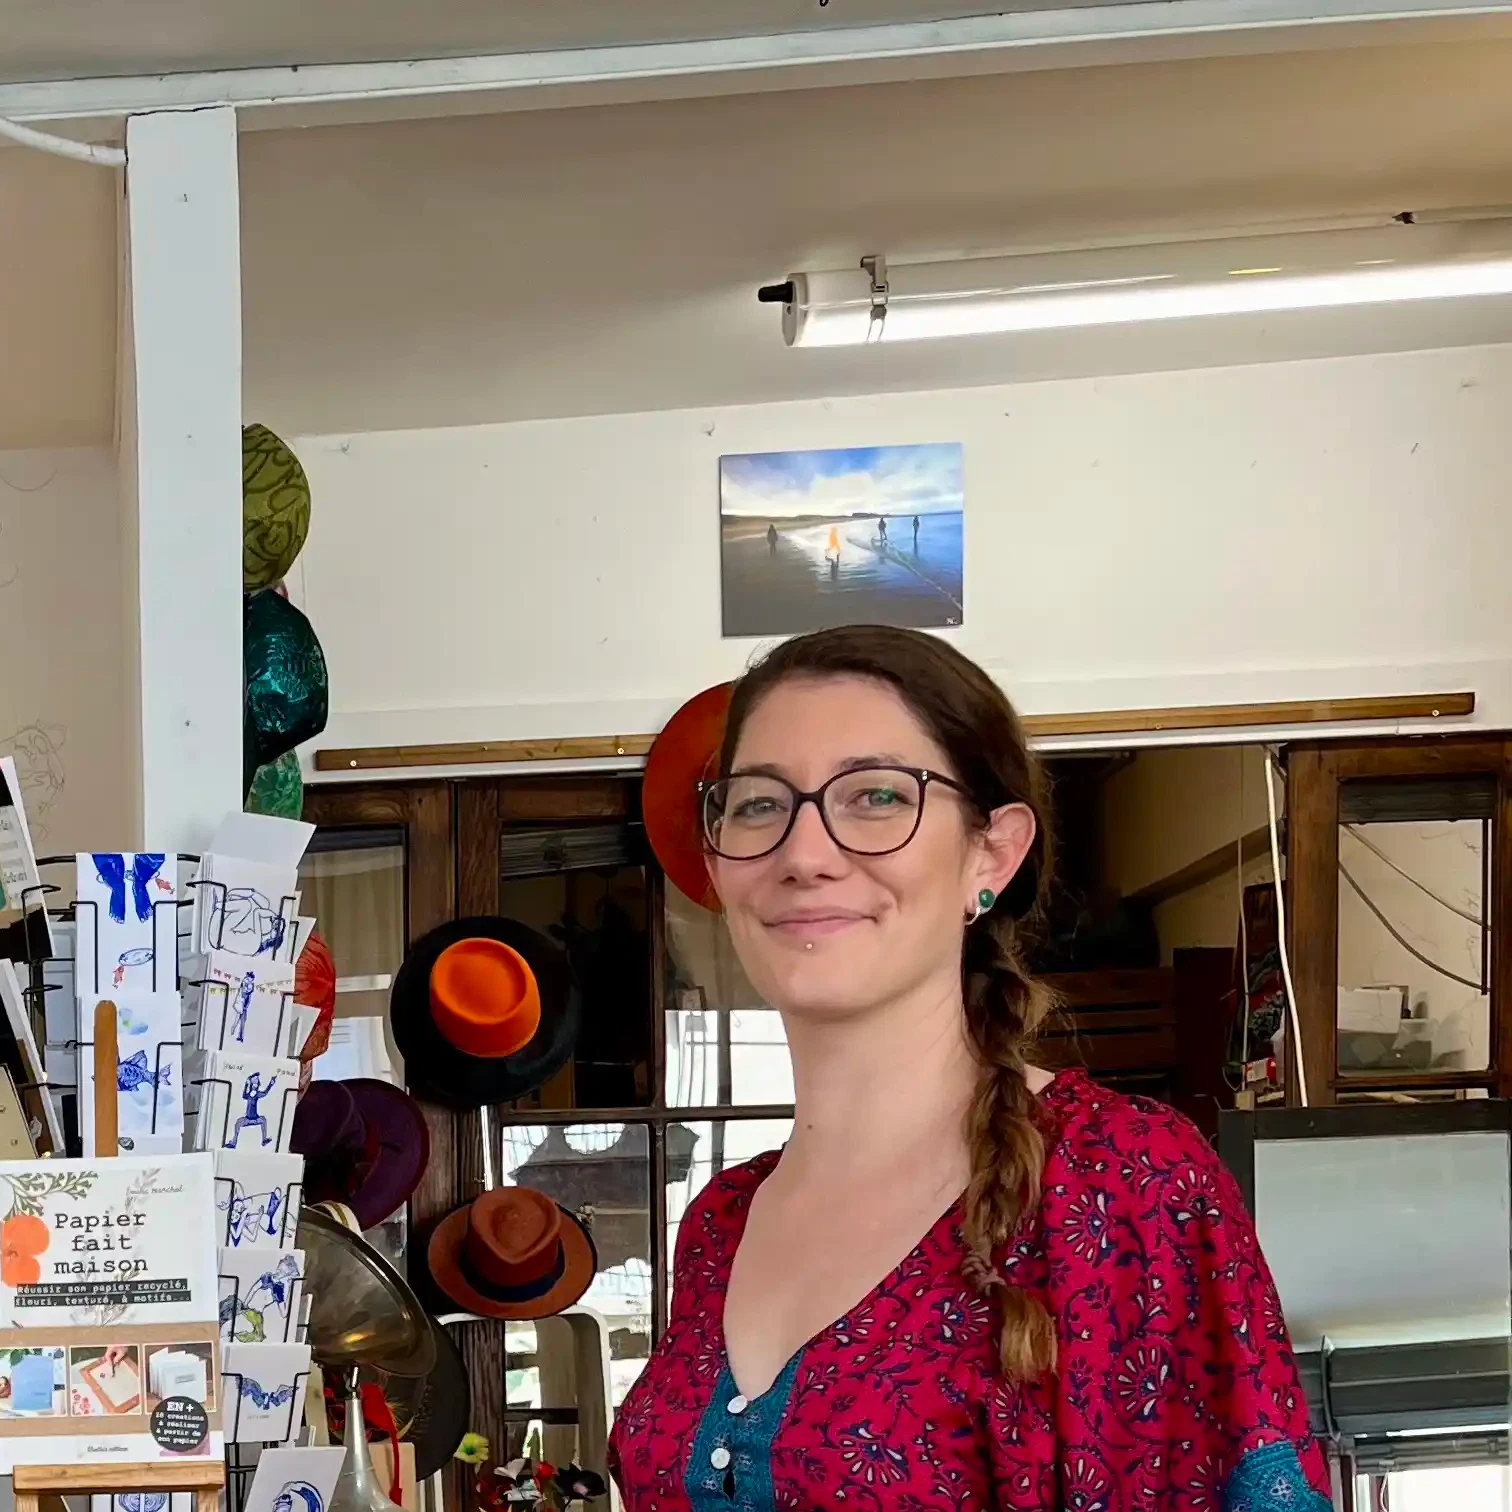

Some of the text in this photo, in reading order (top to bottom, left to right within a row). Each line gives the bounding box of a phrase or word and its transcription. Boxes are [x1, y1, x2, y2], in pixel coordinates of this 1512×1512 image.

[54, 1211, 147, 1232] Papier
[71, 1234, 133, 1252] fait
[54, 1256, 149, 1275] maison
[17, 1279, 186, 1295] Réussir son papier recyclé,
[167, 1401, 184, 1412] EN
